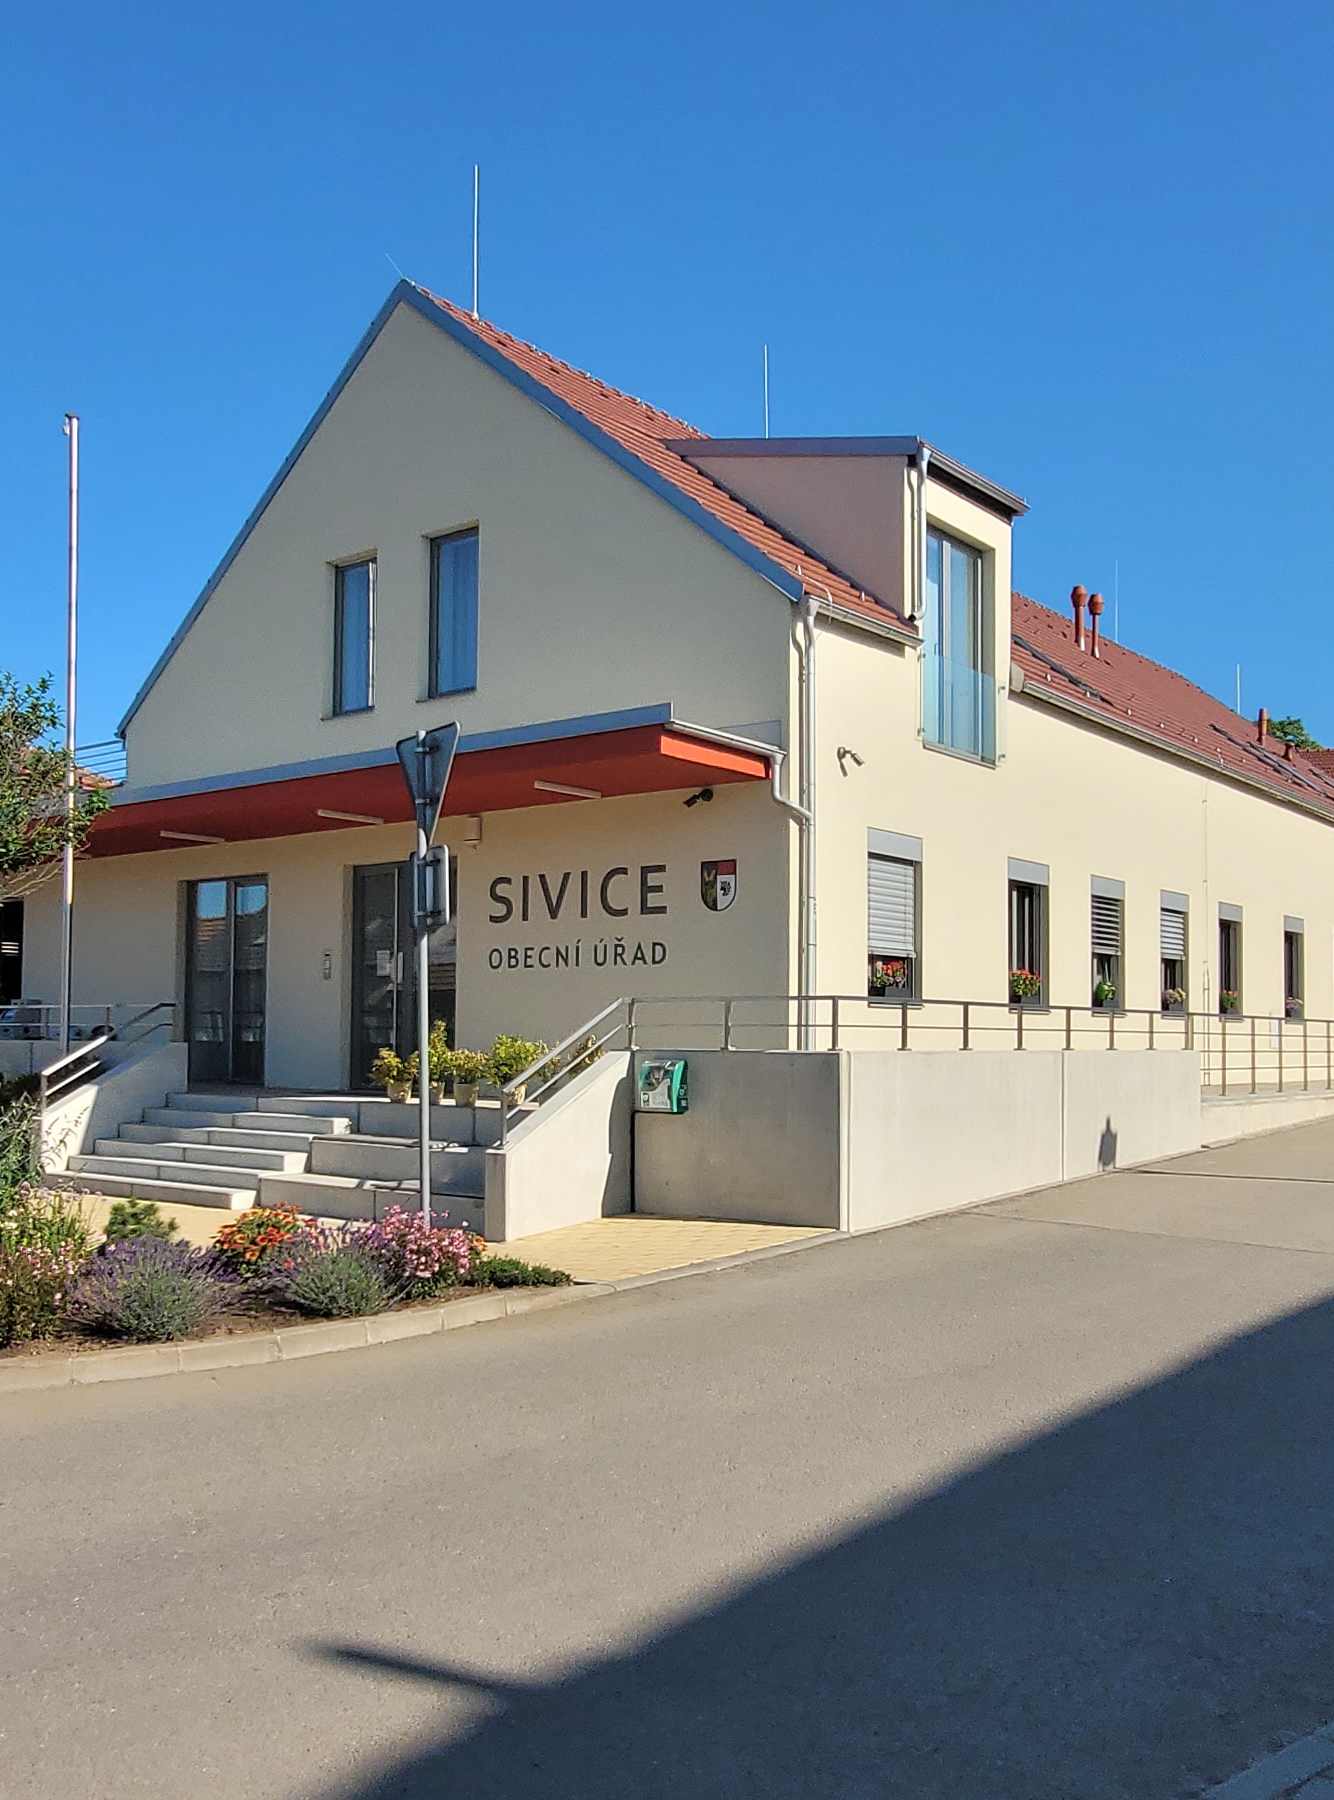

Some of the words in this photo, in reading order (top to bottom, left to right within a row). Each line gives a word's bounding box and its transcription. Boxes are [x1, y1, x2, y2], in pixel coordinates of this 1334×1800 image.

[489, 864, 667, 923] SIVICE
[489, 939, 581, 969] OBECNÍ
[594, 937, 667, 967] ÚŘAD
